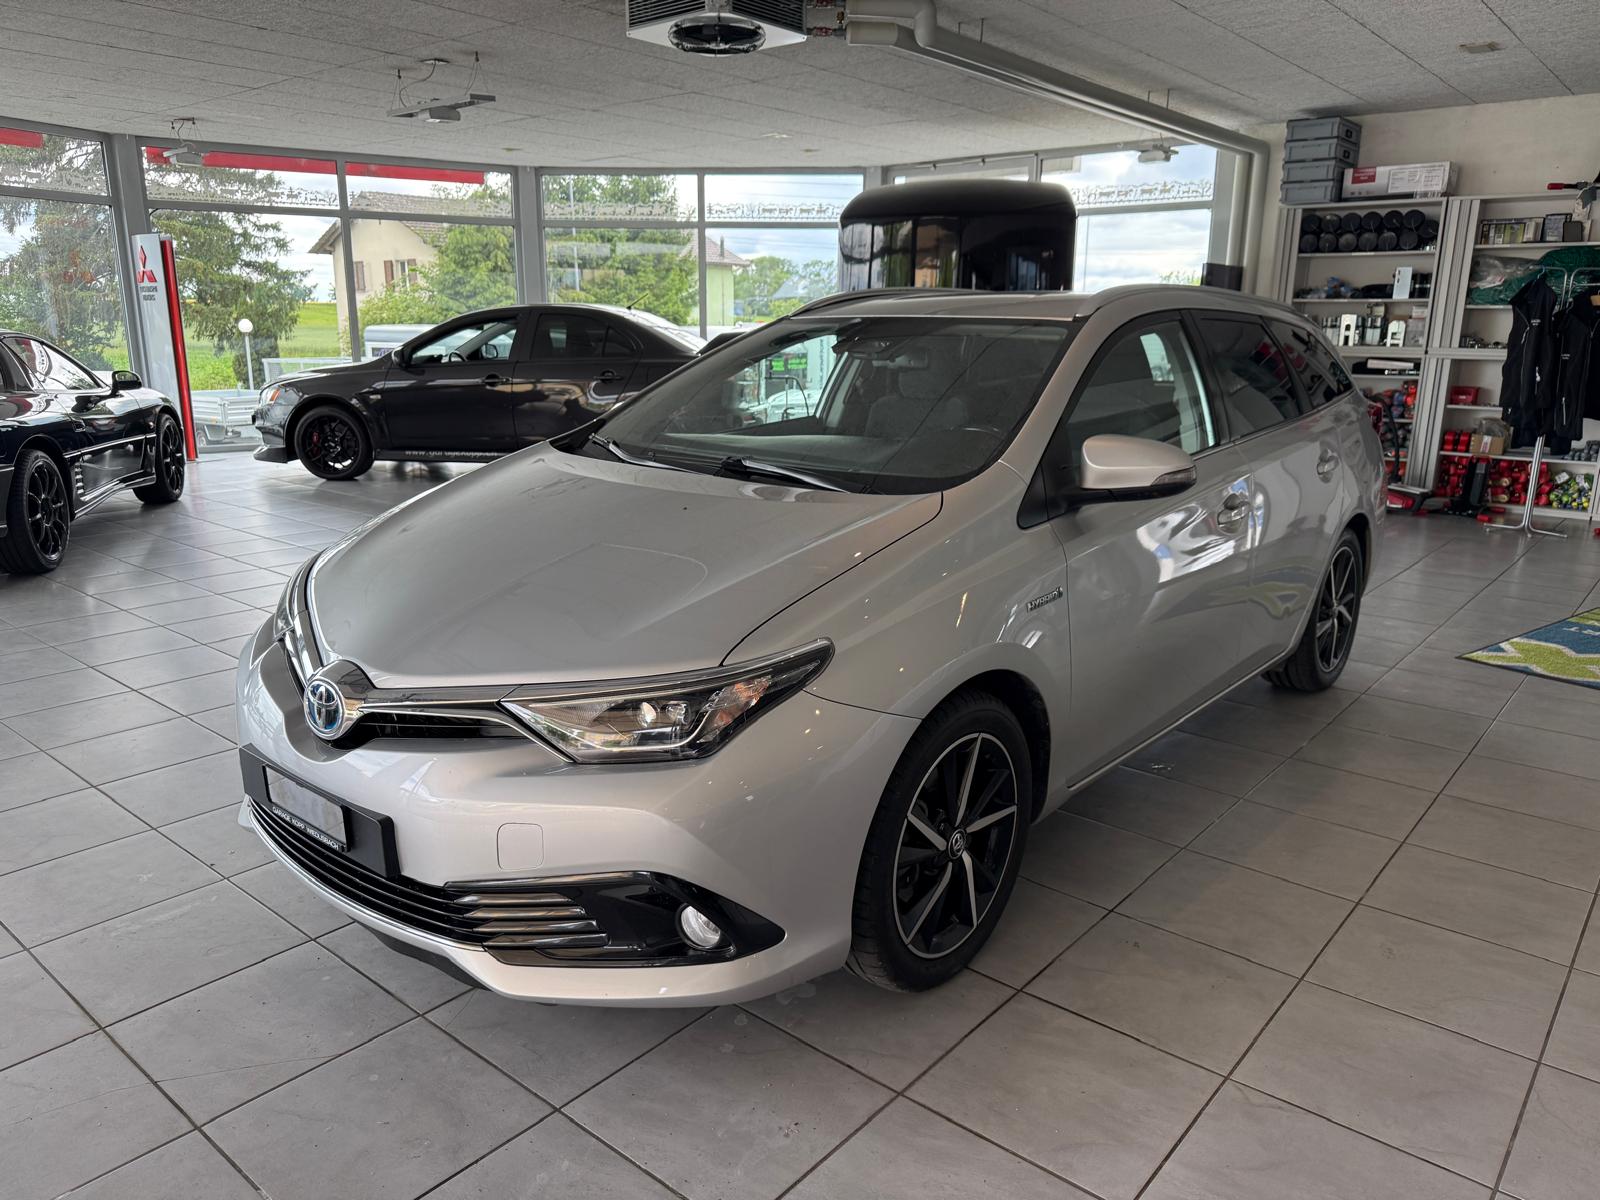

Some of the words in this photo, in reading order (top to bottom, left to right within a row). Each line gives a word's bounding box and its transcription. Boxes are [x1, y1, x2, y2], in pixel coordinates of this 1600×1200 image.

[1027, 590, 1059, 611] HYBRID
[272, 807, 291, 822] GARAGE
[292, 818, 305, 829] KOPP
